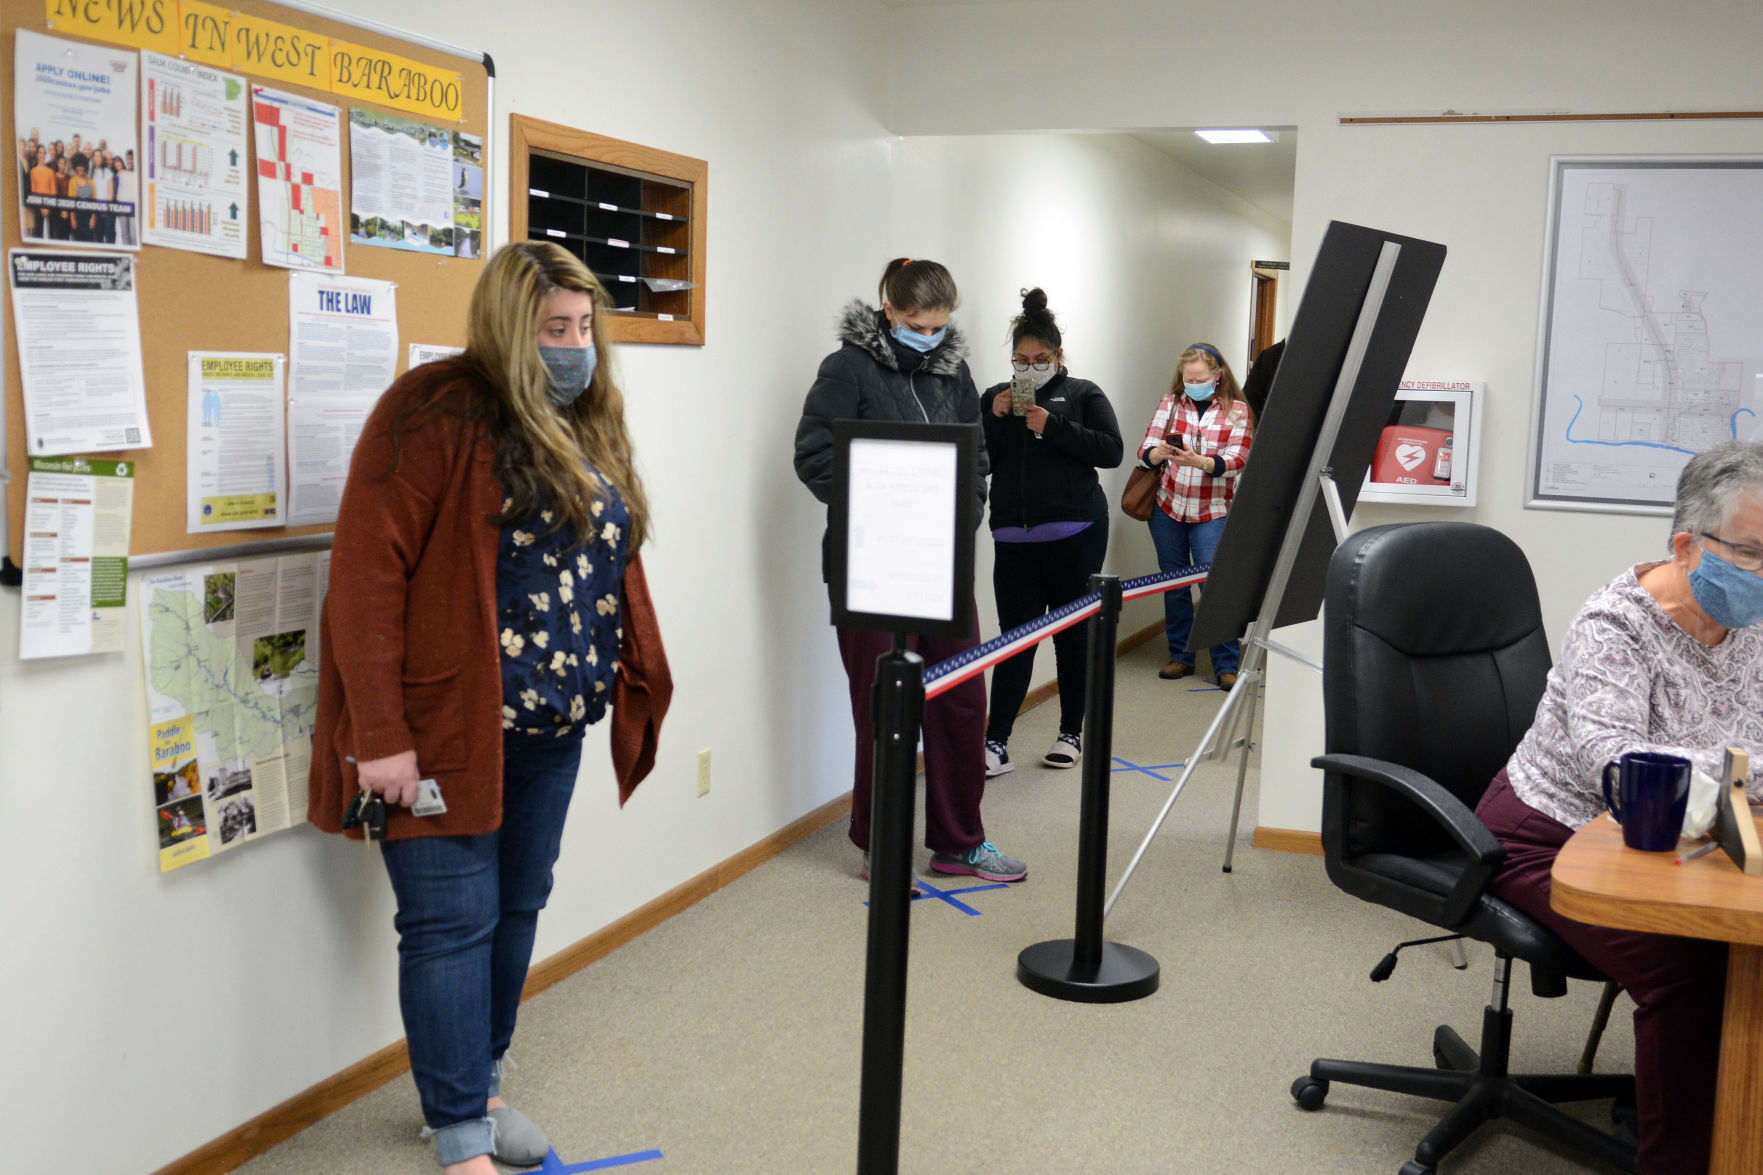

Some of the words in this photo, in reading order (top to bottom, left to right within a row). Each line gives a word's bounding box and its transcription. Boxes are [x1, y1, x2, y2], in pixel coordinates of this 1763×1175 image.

[185, 12, 230, 53] IN
[236, 27, 321, 77] WEST
[333, 51, 459, 112] BARABOO
[35, 63, 65, 77] APPLY
[67, 70, 111, 85] ONLINE!
[197, 71, 218, 82] INDEX
[26, 195, 42, 204] JOIN
[43, 197, 57, 206] THE
[58, 199, 75, 208] 2020
[76, 200, 108, 211] CENSUS
[109, 203, 132, 213] TEAM
[16, 259, 76, 273] EMPLOYEE
[78, 262, 115, 273] RIGHTS
[318, 290, 342, 312] THE
[345, 292, 372, 315] LAW
[201, 360, 243, 372] EMPLOYEE
[245, 361, 273, 372] RIGHTS
[1417, 381, 1470, 390] DEFIBRILLATOR
[1395, 476, 1417, 484] AED
[156, 724, 181, 740] Paddle
[155, 741, 191, 761] Baraboo
